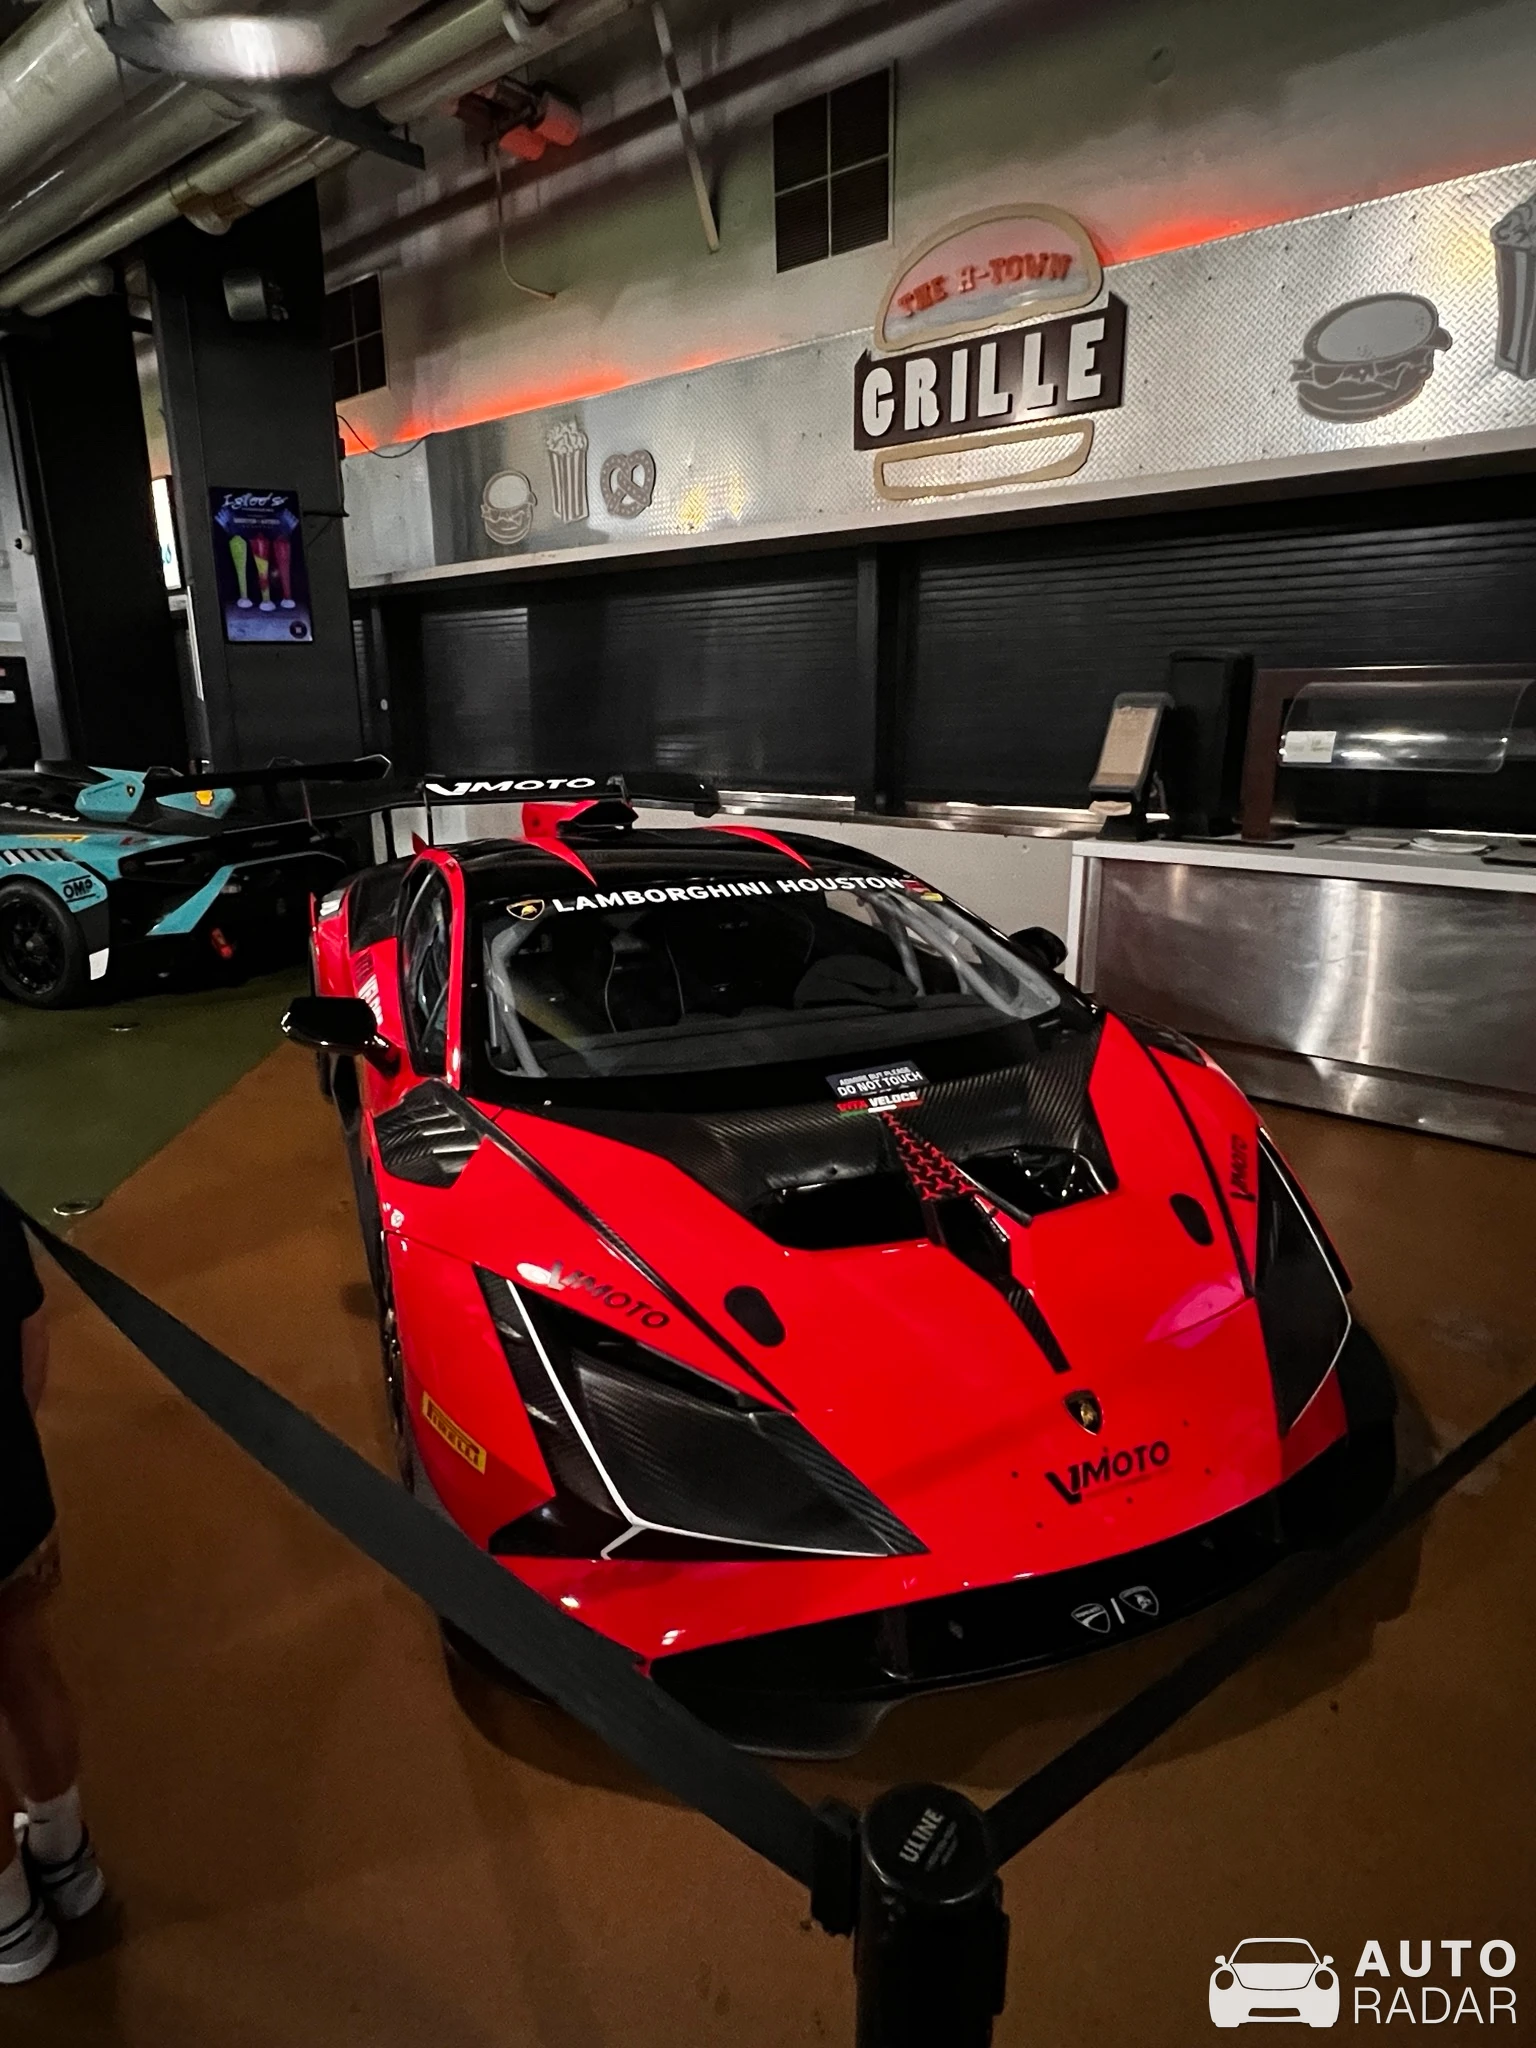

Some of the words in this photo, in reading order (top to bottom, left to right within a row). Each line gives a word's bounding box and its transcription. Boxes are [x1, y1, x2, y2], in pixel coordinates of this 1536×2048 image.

[862, 318, 1105, 437] GRILLE
[425, 777, 596, 796] VMOTO
[63, 879, 94, 898] OMP
[552, 880, 773, 912] LAMBORGHINI
[777, 876, 906, 894] HOUSTON
[837, 1084, 856, 1097] DO
[857, 1078, 882, 1092] NOT
[882, 1071, 924, 1087] TOUCH
[868, 1091, 918, 1108] VELOCE
[548, 1260, 670, 1329] VMOTO
[1044, 1440, 1171, 1505] VMOTO
[899, 1808, 945, 1864] ULINE
